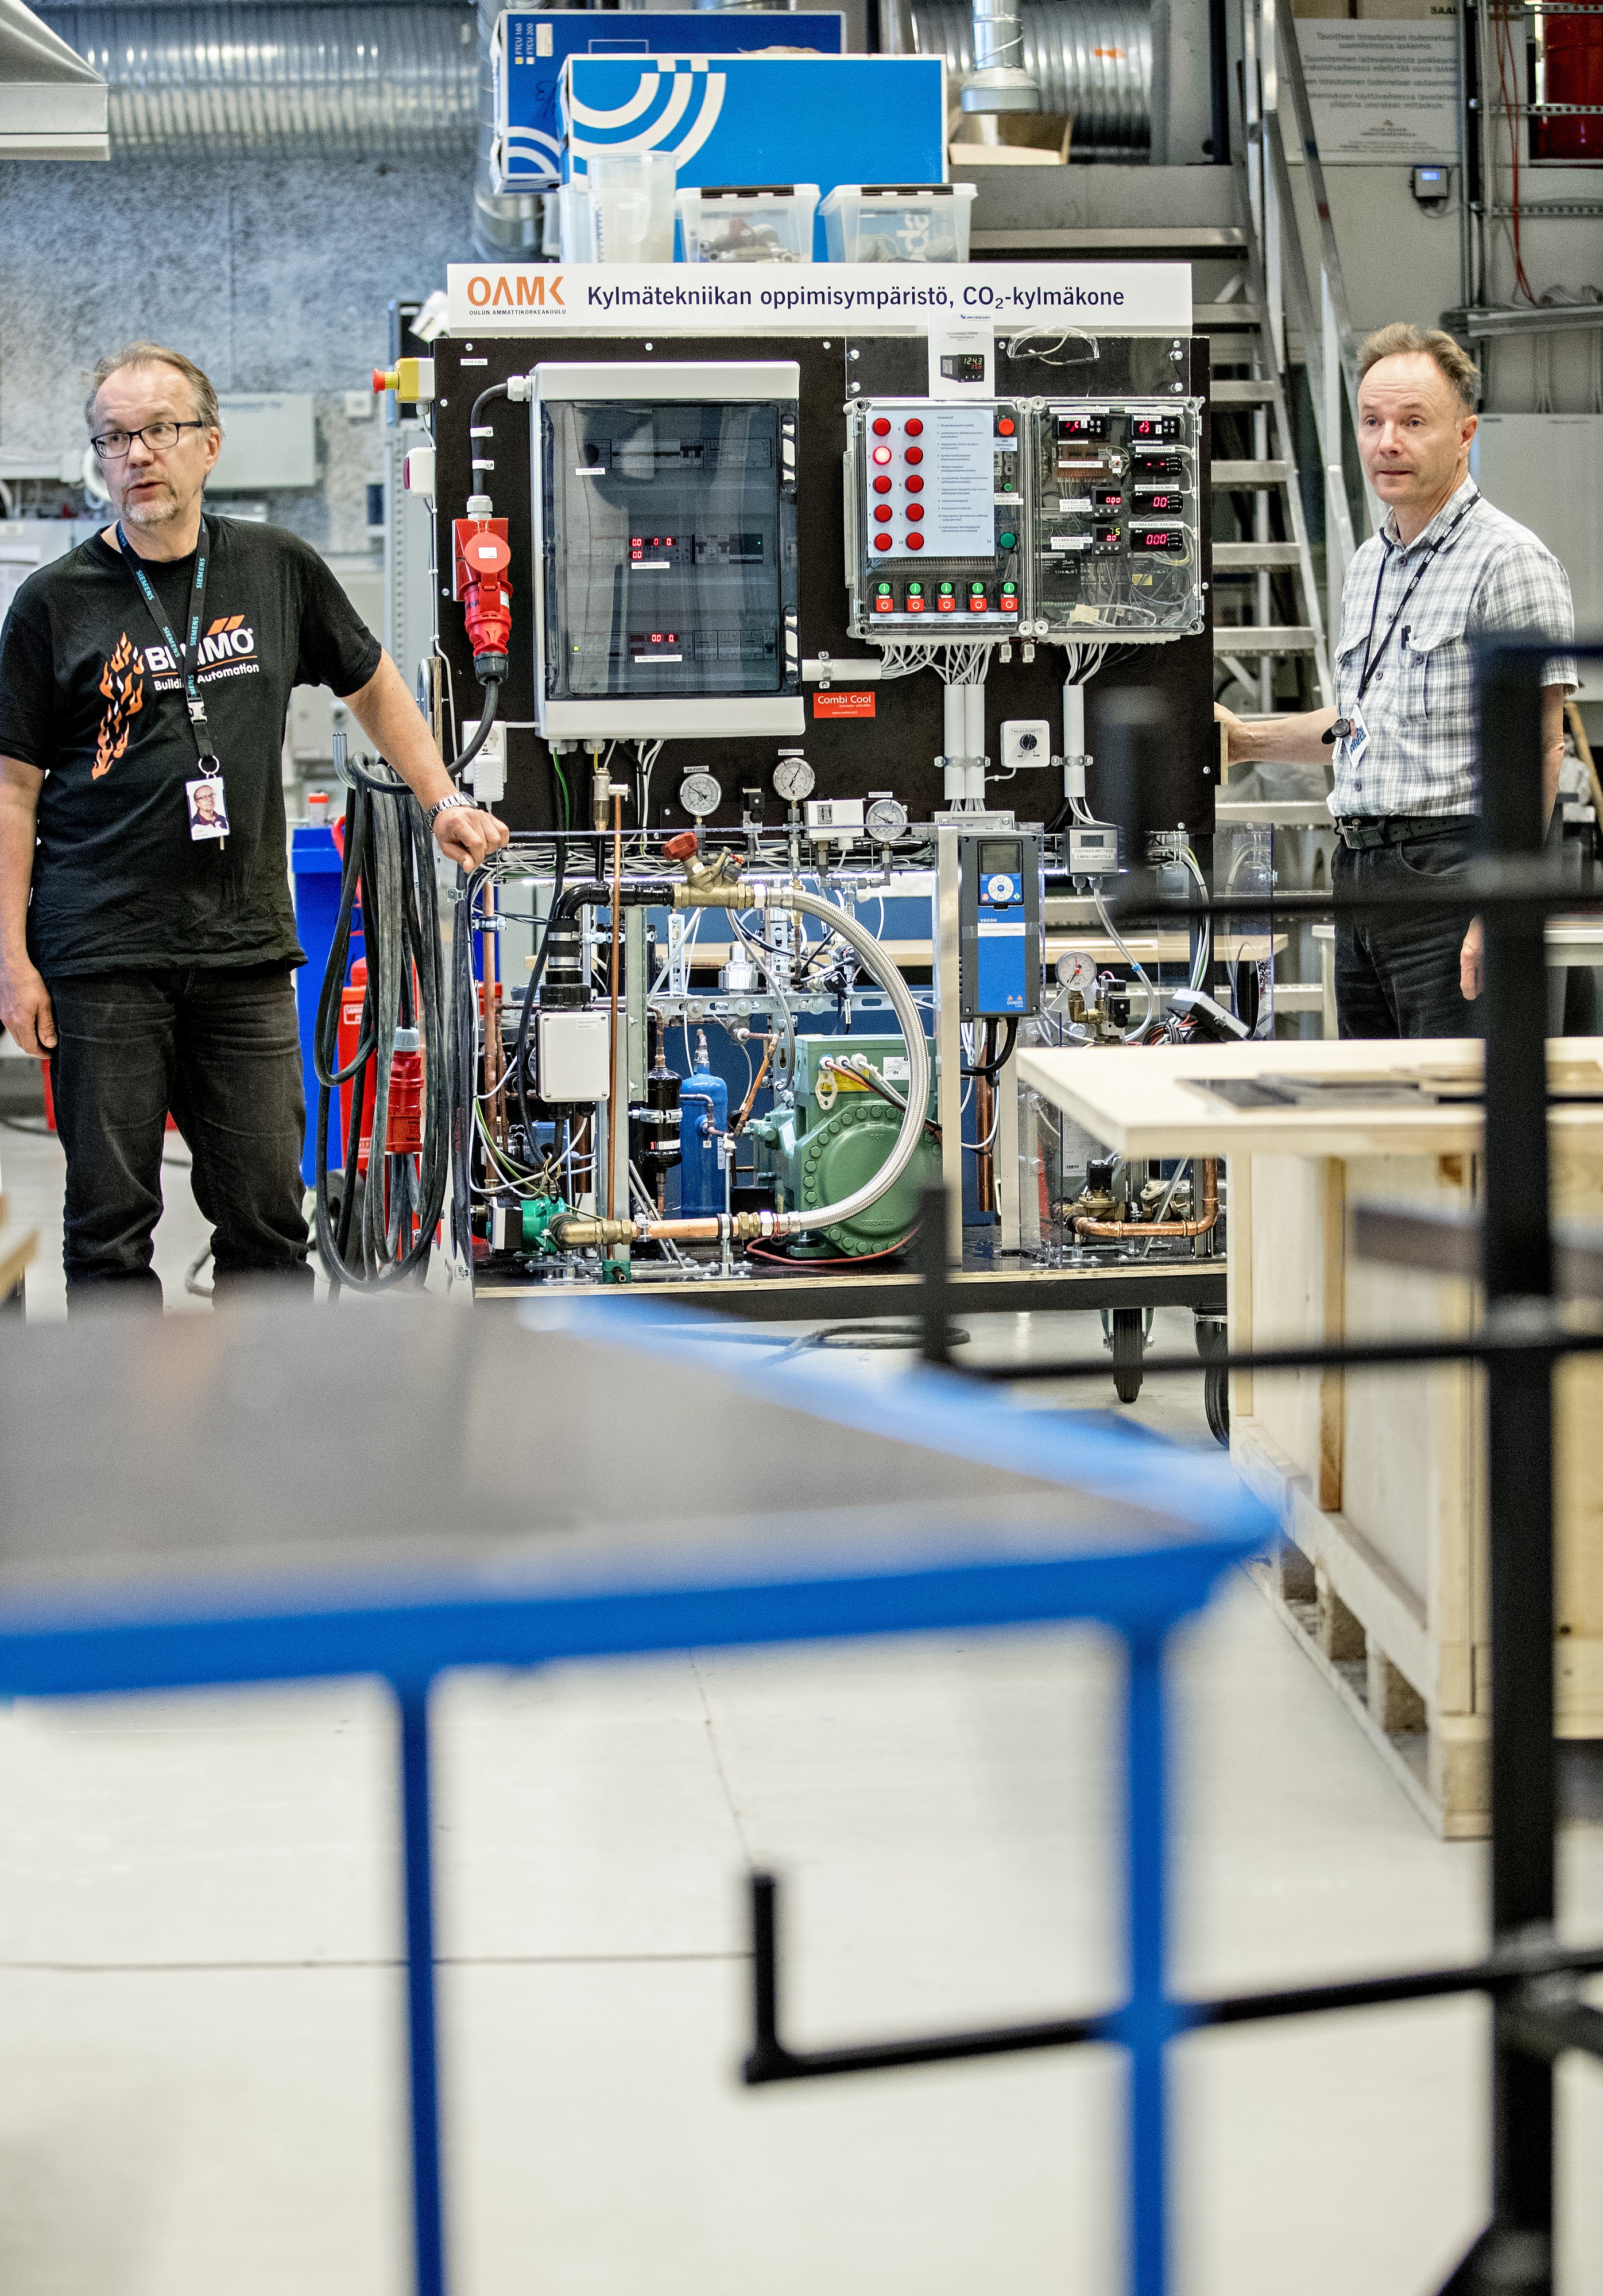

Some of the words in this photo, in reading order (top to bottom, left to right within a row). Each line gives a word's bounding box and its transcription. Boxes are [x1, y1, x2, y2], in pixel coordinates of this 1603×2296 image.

[588, 286, 752, 309] Kylmätekniikan
[761, 286, 954, 309] oppimisympäristö,
[136, 569, 154, 600] SIEMENS
[196, 557, 206, 589] SIEMENS
[162, 626, 181, 658] SIEMENS
[189, 616, 199, 646] SIEMENS
[197, 663, 260, 684] Automation
[818, 695, 847, 704] Combi
[850, 695, 871, 703] Cool
